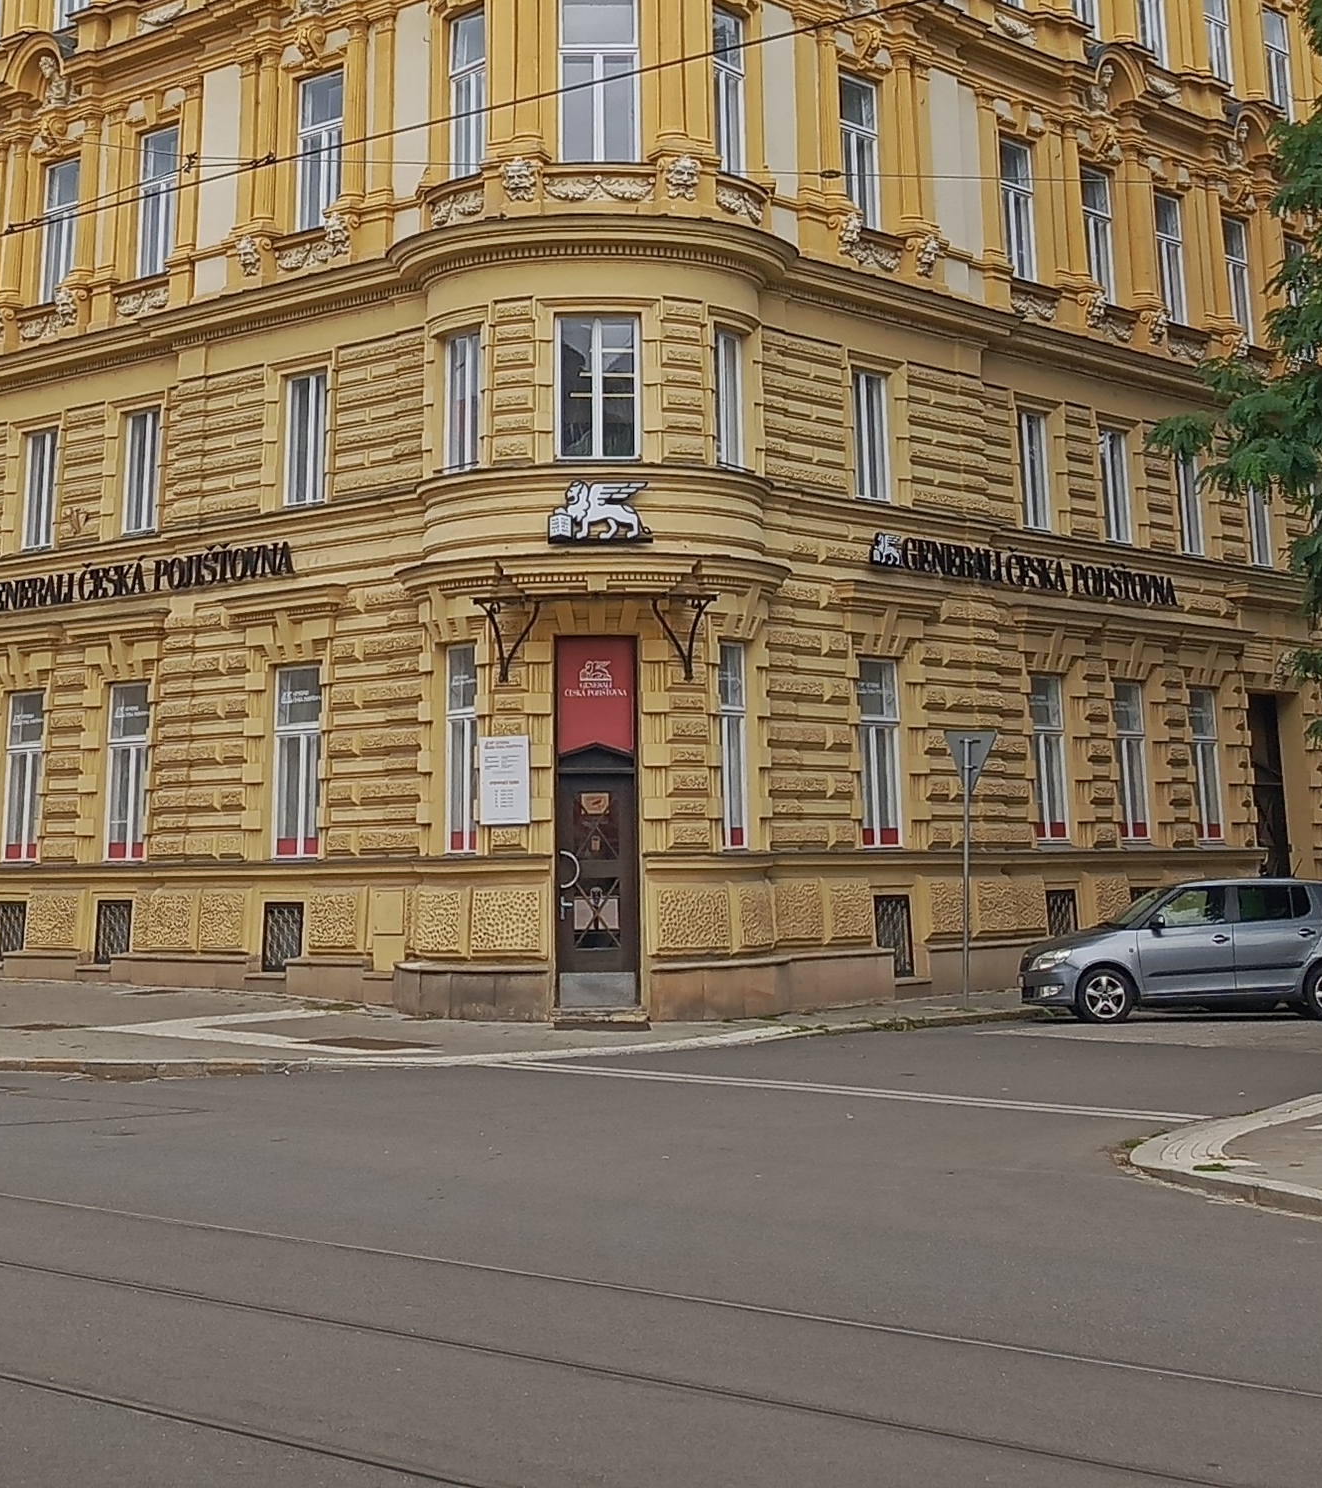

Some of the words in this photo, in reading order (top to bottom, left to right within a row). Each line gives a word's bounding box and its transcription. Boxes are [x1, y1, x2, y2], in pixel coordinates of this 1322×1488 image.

[77, 554, 148, 602] ČESKÁ
[152, 542, 295, 592] POJIŠŤOVNA
[900, 536, 1004, 584] GENERALI
[1005, 546, 1069, 593] ČESKÁ
[1071, 562, 1178, 607] POJIŠŤOVNA
